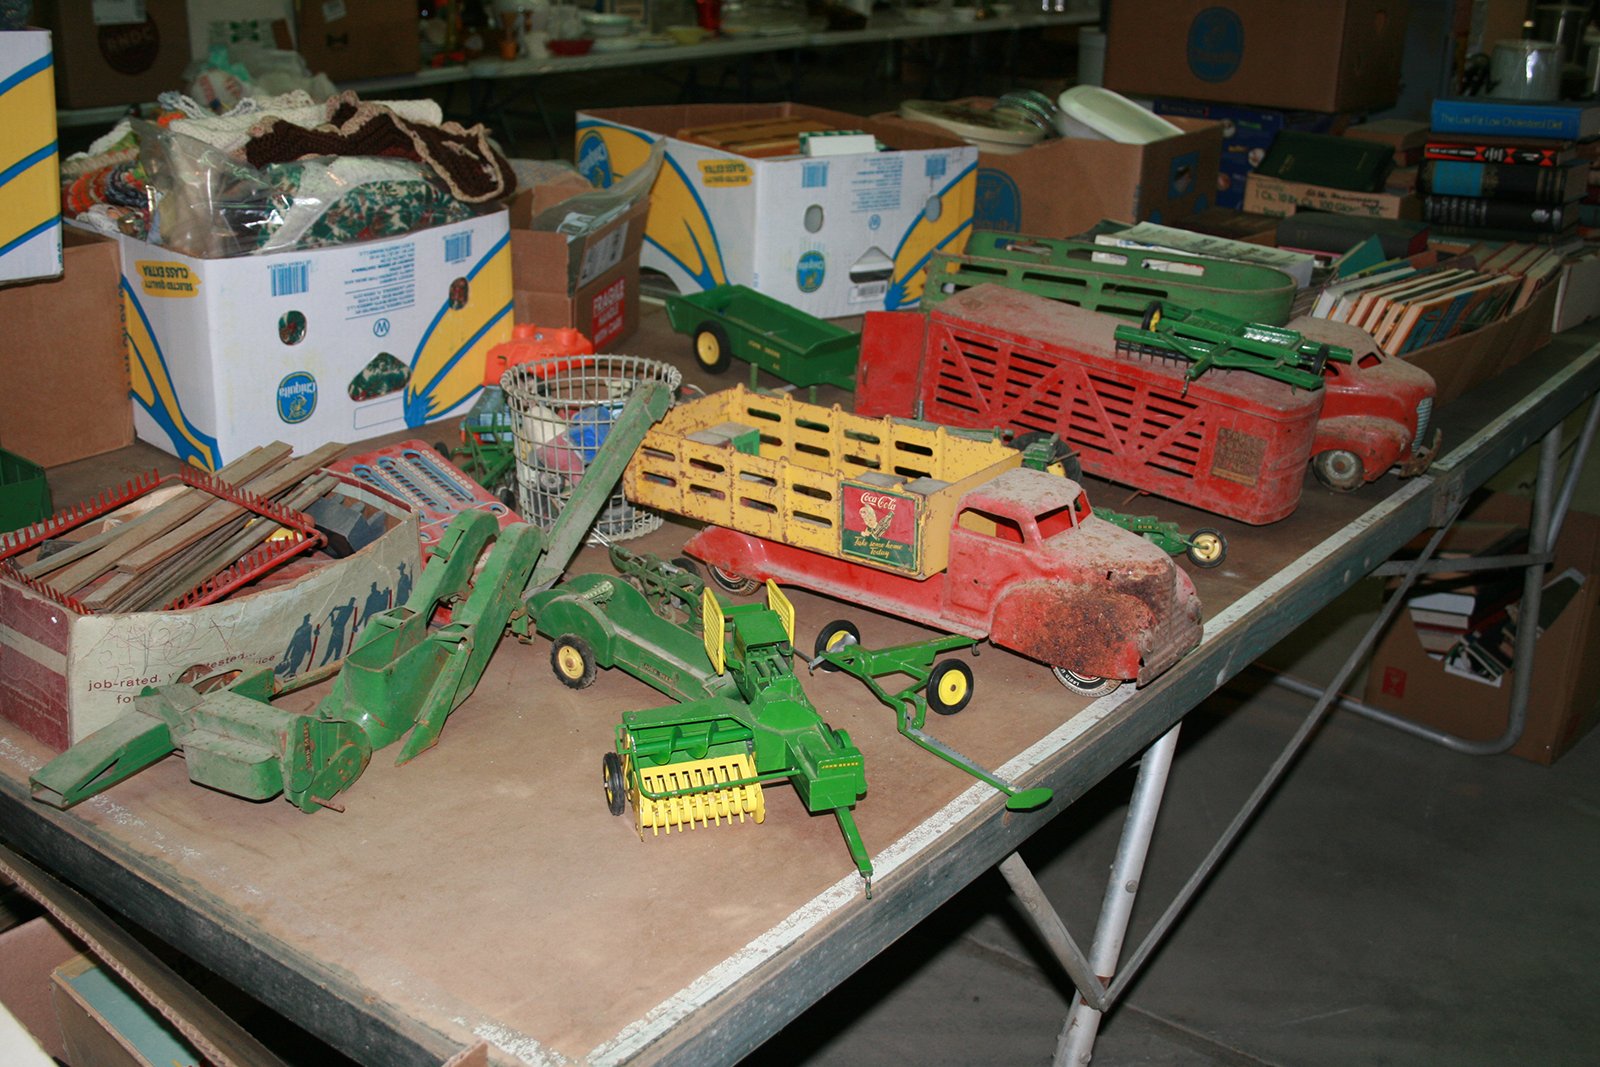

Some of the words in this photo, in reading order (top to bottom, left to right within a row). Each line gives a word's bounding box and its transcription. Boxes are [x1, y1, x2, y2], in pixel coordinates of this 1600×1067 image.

[1440, 112, 1455, 123] The
[142, 265, 165, 278] EXTRA
[165, 264, 189, 279] CLASS
[279, 381, 316, 398] Chiquita
[853, 535, 868, 547] Take
[869, 540, 884, 549] some
[885, 540, 903, 550] home
[870, 546, 890, 559] Today
[87, 674, 162, 692] job-rated.
